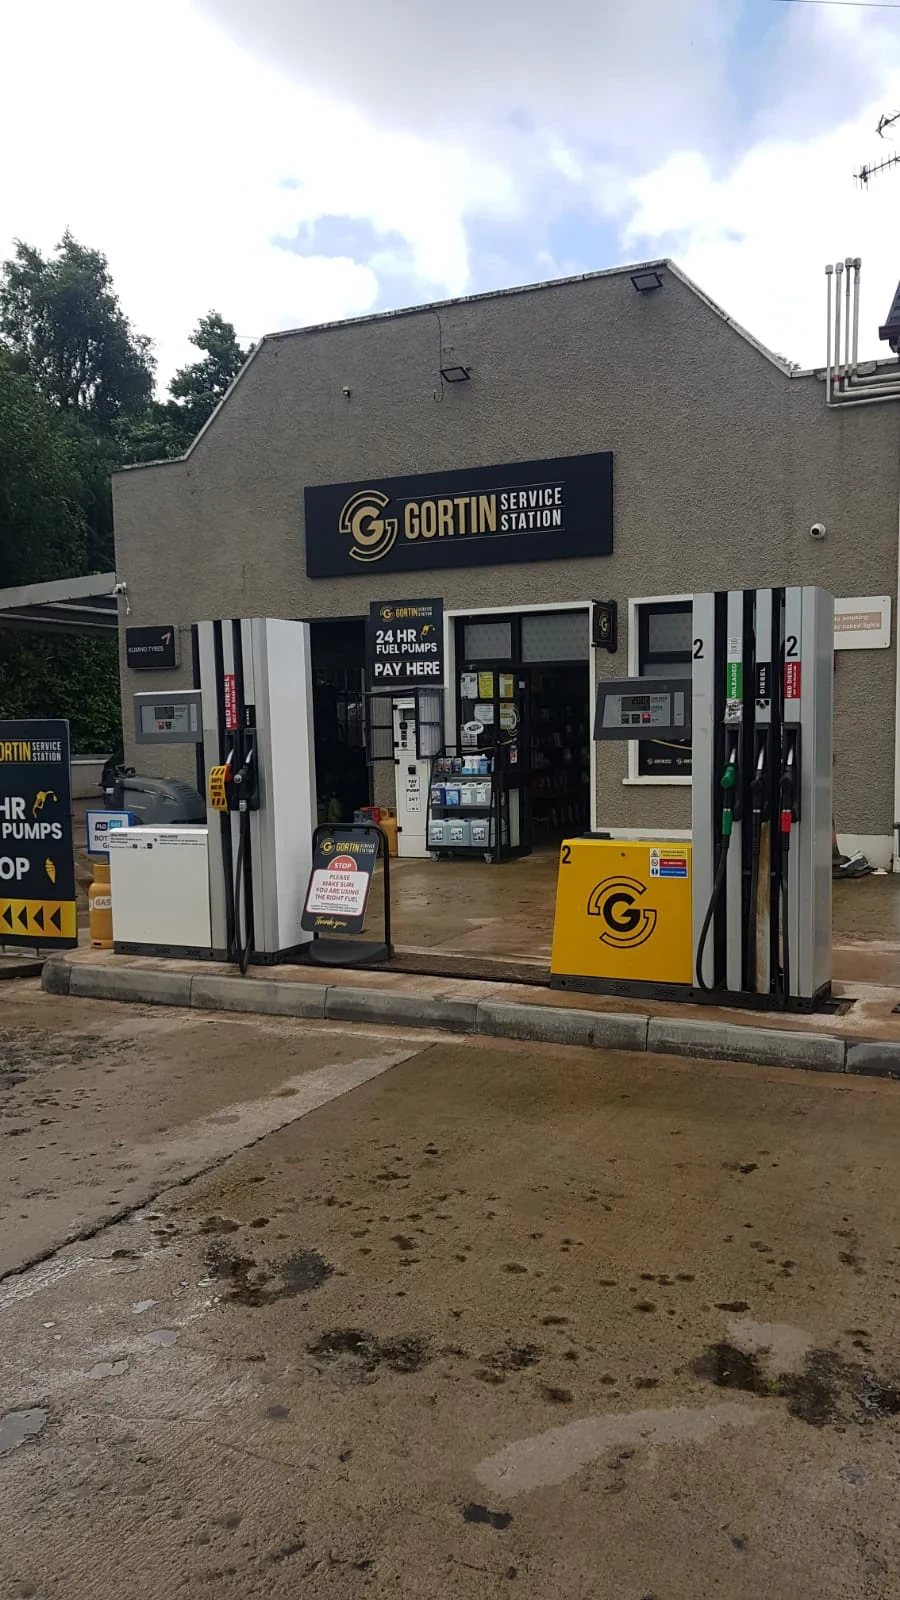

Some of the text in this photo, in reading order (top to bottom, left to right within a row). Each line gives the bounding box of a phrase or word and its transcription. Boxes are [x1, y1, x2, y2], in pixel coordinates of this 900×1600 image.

[501, 488, 562, 510] SERVICE
[405, 495, 496, 539] GORTIN
[501, 509, 562, 531] STATION
[396, 607, 418, 618] GORTIN
[376, 628, 417, 644] 24 HR
[376, 642, 438, 655] FUEL PUMPS
[693, 638, 704, 660] 2
[786, 635, 798, 657] 2
[374, 661, 440, 677] PAY HERE
[32, 741, 62, 751] SERVICE
[32, 752, 62, 762] STATION
[0, 797, 26, 820] HR
[2, 822, 63, 840] PUMPS
[336, 842, 360, 854] GORTIN
[562, 845, 572, 864] 2
[334, 862, 352, 870] STOP
[95, 898, 111, 906] GAS
[315, 916, 348, 929] Thank you
